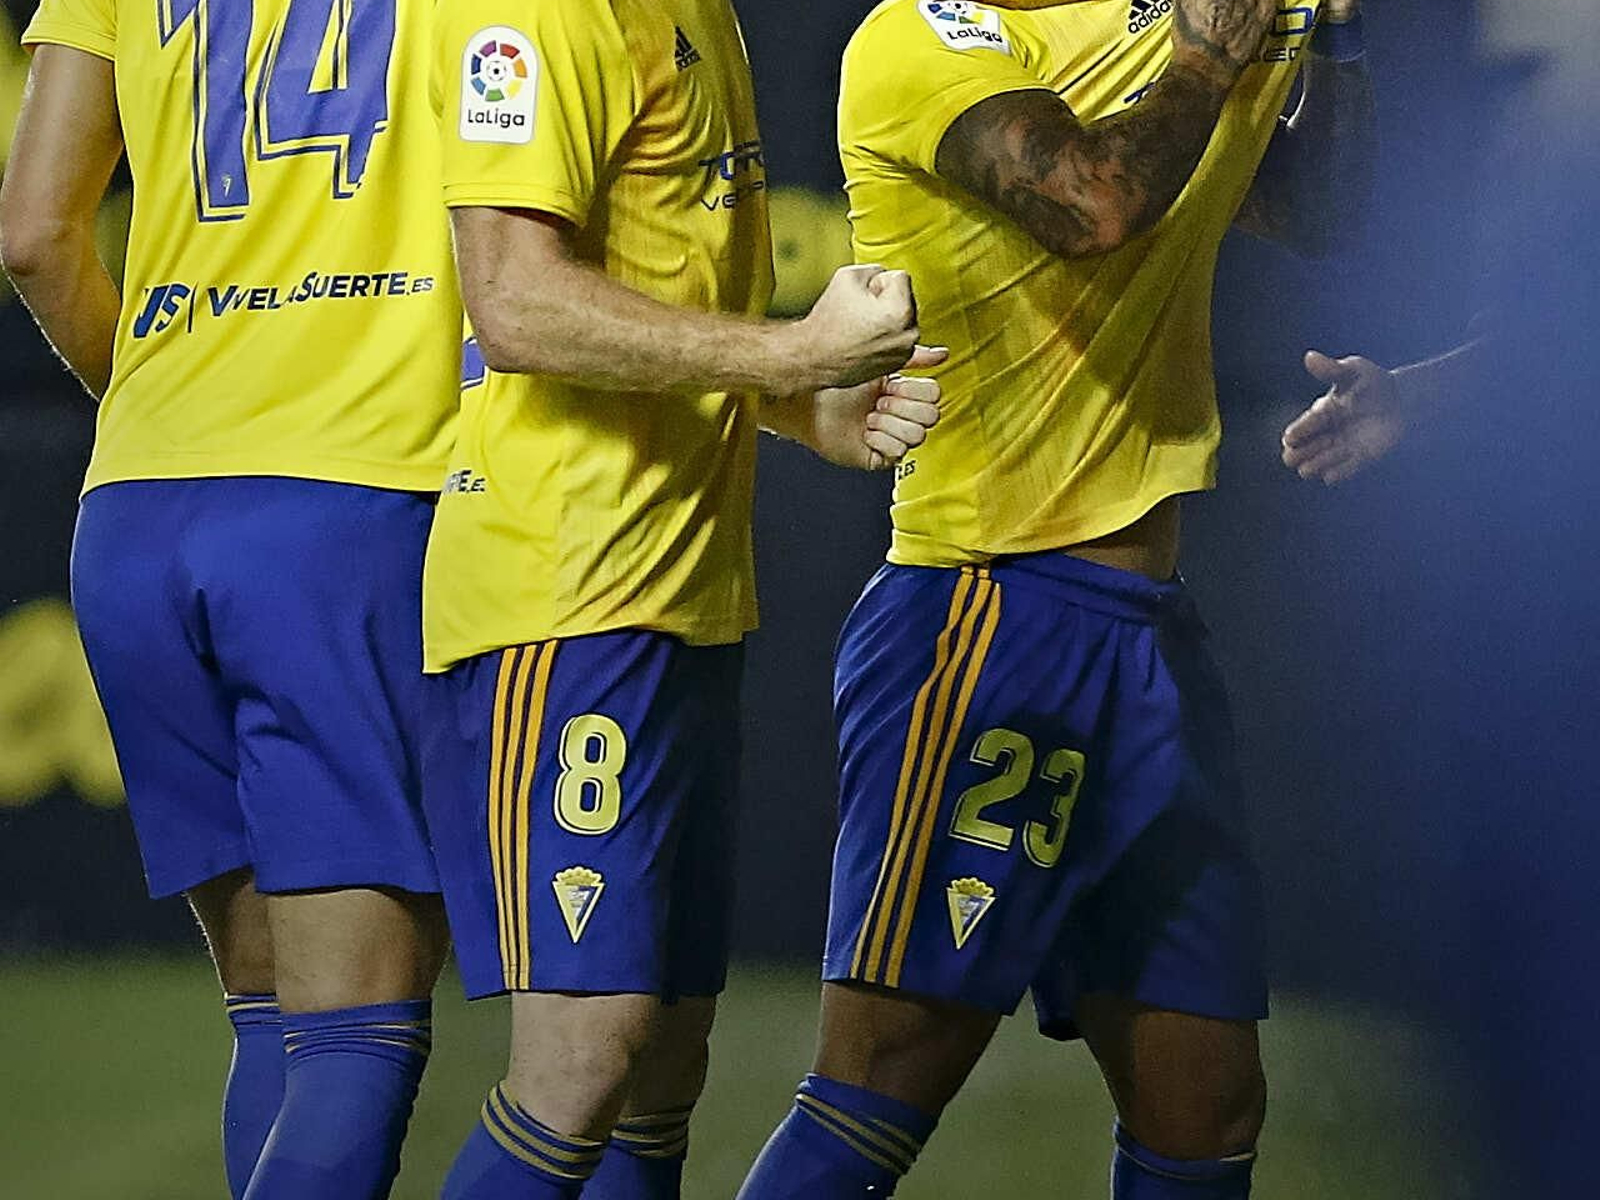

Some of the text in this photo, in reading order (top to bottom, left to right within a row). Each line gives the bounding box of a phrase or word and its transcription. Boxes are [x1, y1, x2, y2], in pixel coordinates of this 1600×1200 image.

[468, 107, 526, 129] LaLiga
[554, 714, 627, 835] 8
[947, 727, 1087, 868] 23
